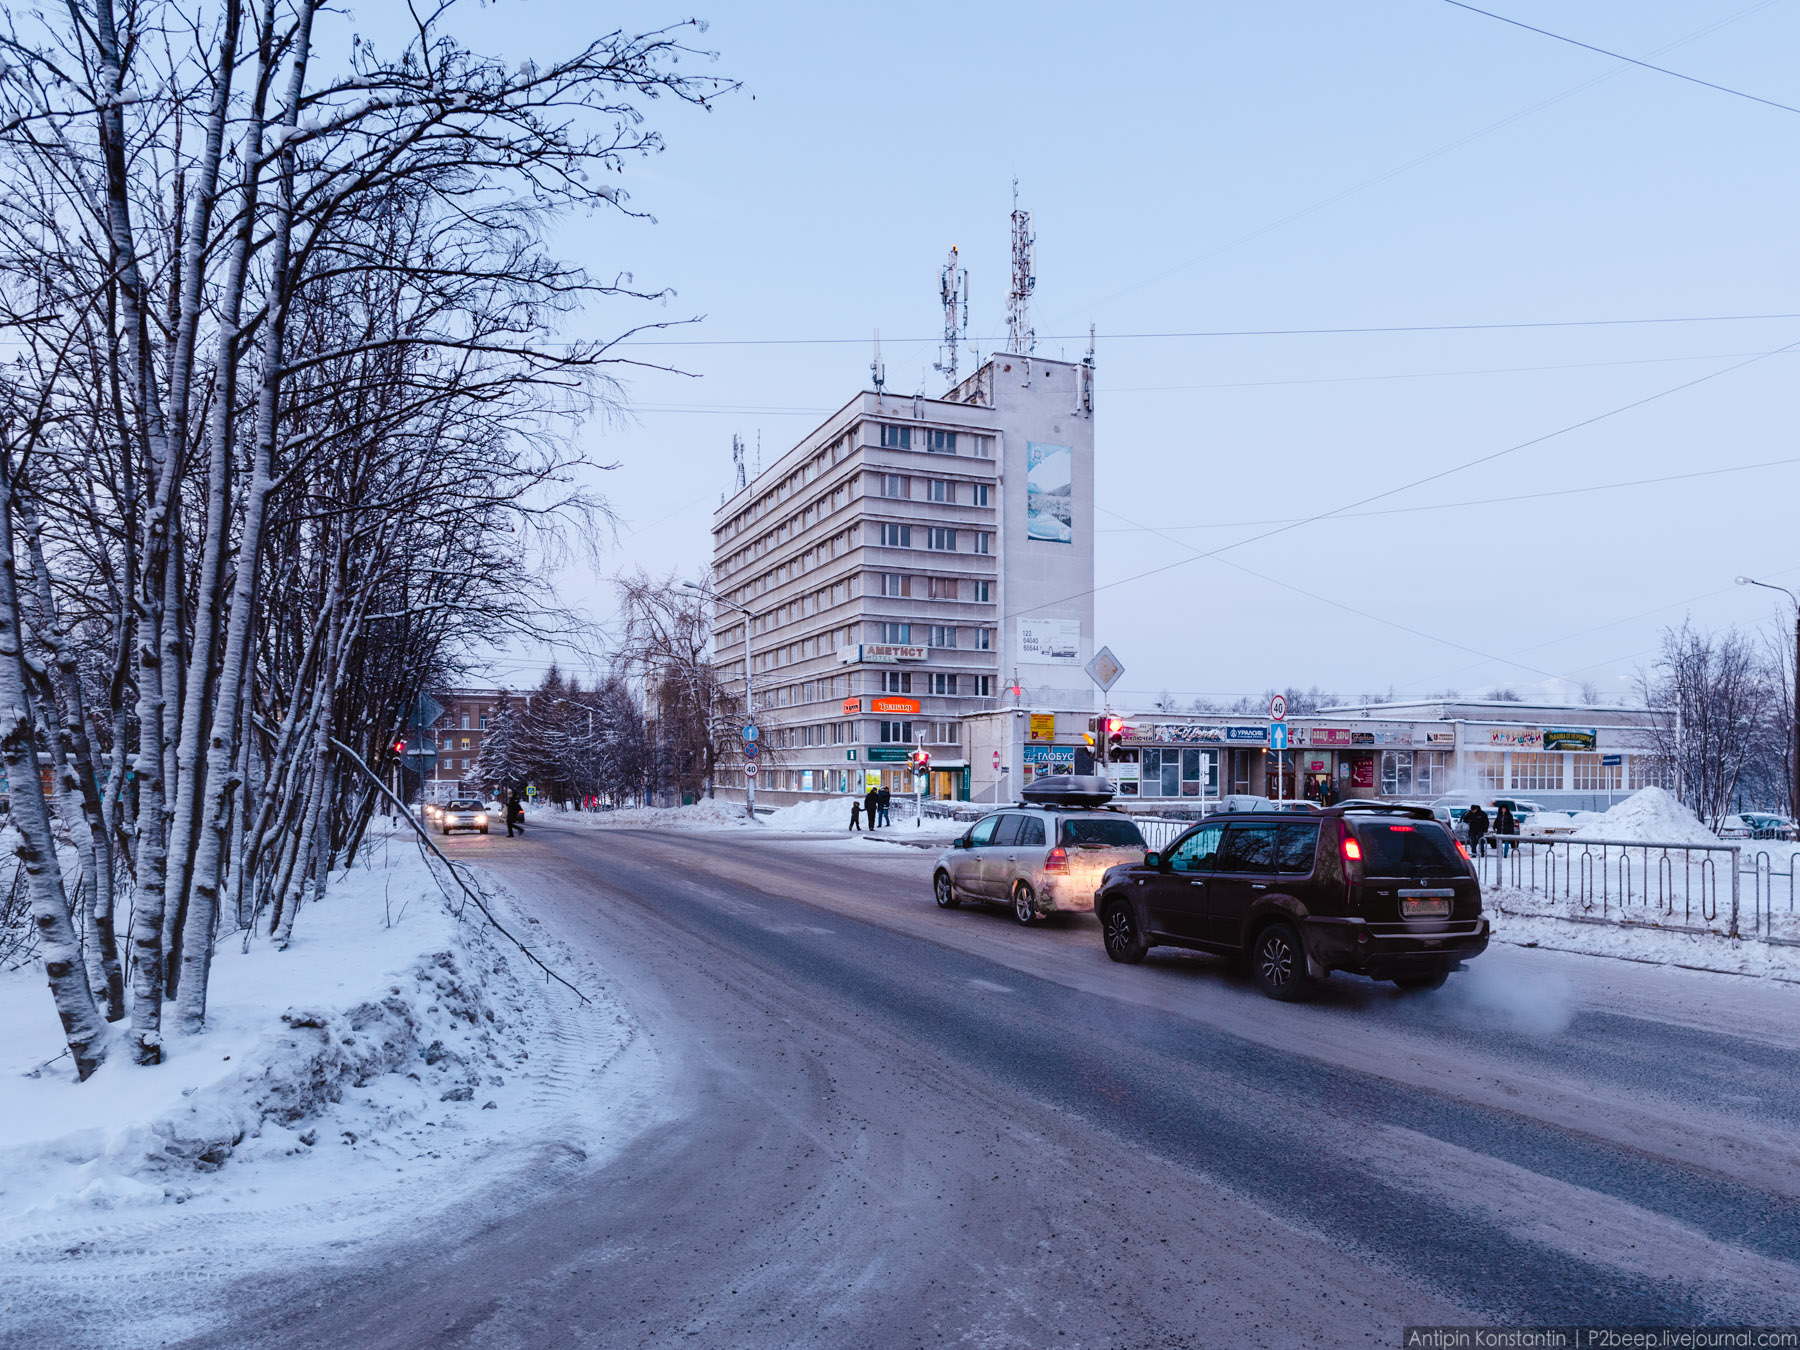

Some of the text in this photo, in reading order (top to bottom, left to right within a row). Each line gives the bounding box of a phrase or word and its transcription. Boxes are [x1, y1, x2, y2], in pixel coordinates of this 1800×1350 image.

[867, 646, 924, 658] АМЕТИСТ
[1273, 703, 1283, 713] 40
[1037, 752, 1075, 761] ГЛОБУС
